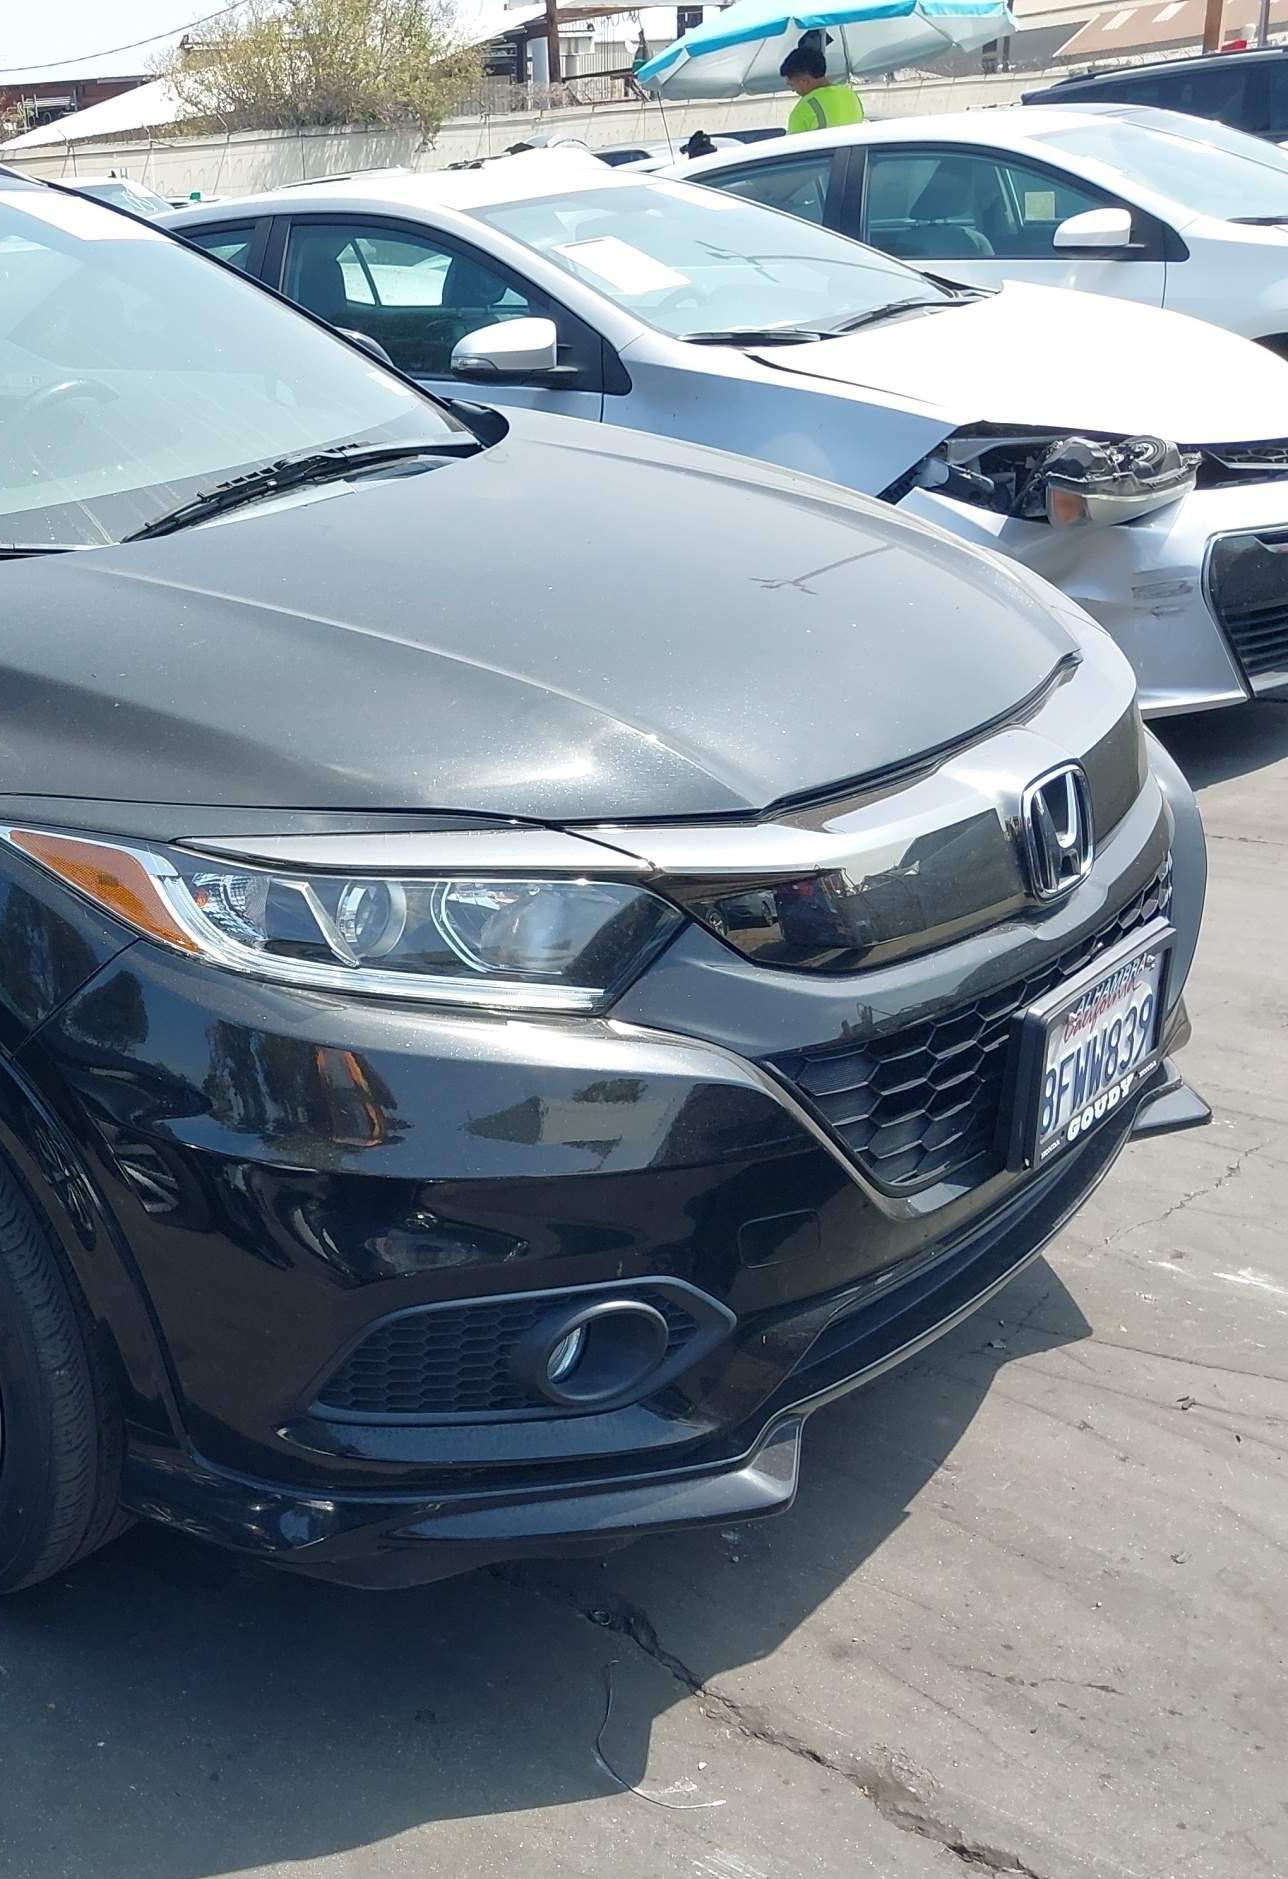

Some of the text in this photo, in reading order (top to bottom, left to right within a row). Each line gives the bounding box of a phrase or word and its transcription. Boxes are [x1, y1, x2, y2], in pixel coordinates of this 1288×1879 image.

[1063, 976, 1143, 1043] California
[1074, 951, 1149, 1015] ALHAMBRA
[1039, 993, 1154, 1135] 8FWW839
[1067, 1071, 1134, 1141] GOUDY
